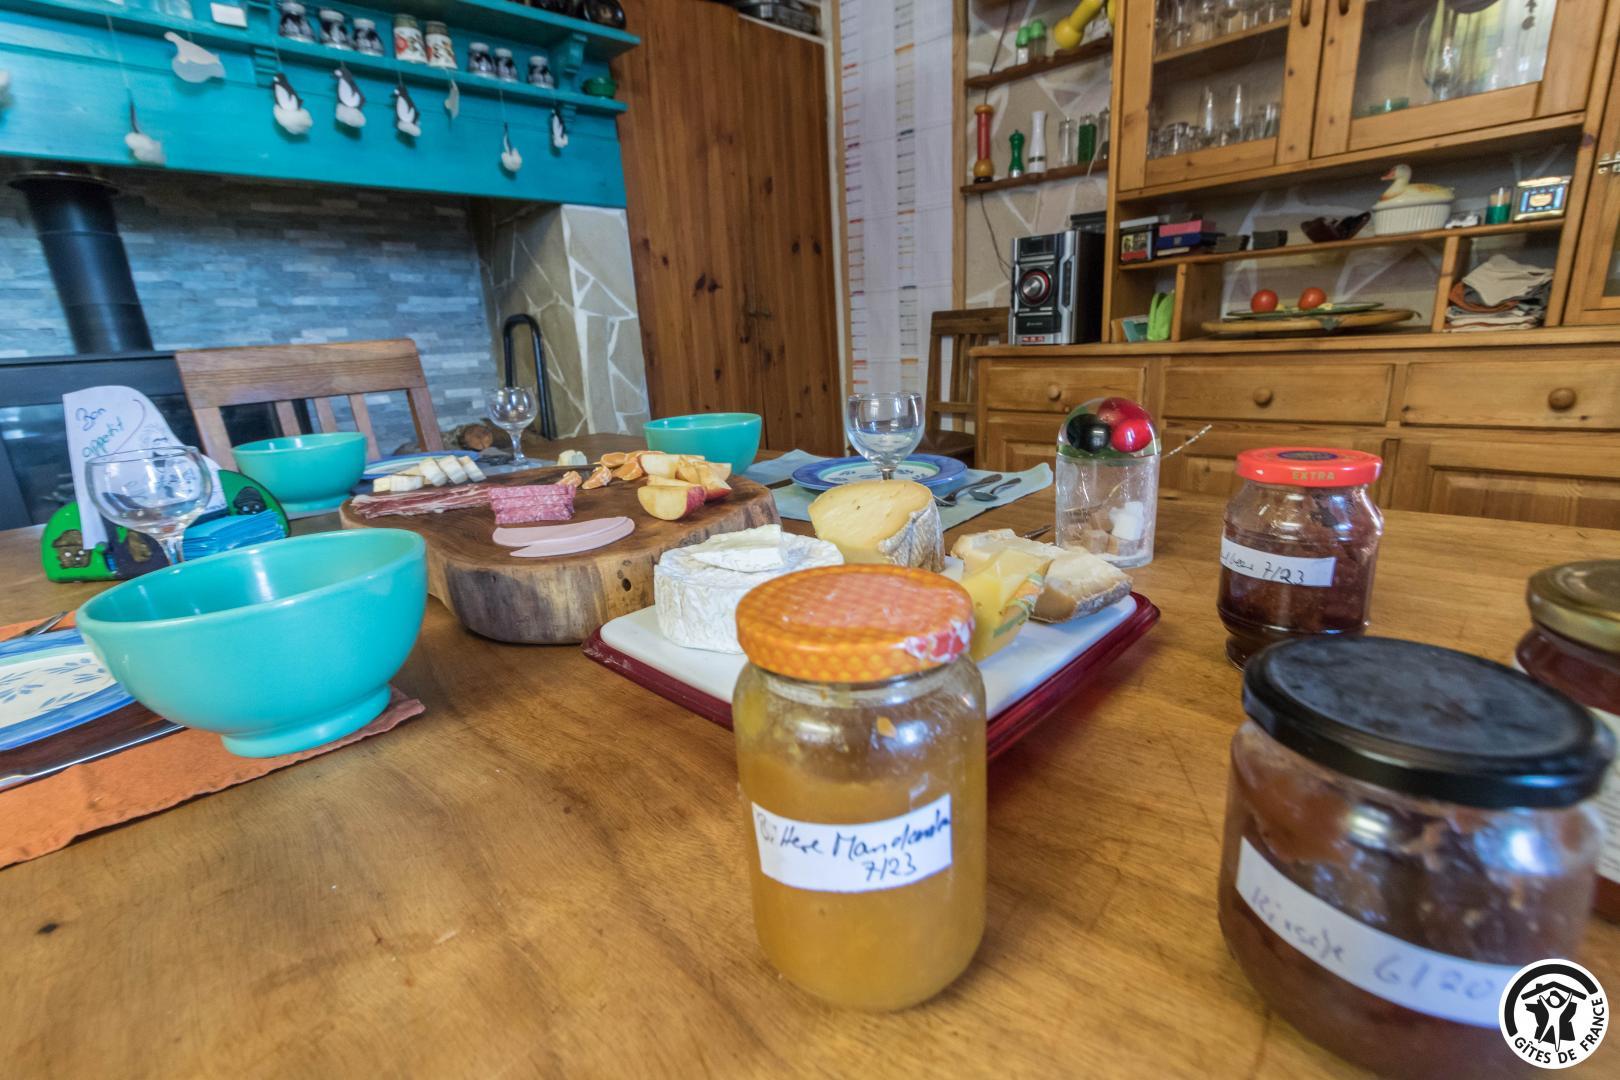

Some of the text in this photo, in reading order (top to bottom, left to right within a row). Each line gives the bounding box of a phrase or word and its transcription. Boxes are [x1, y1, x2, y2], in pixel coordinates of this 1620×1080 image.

[75, 407, 107, 432] Bon
[1291, 470, 1336, 481] EXTRA
[1262, 560, 1305, 585] 7/23
[861, 852, 918, 882] 7/23
